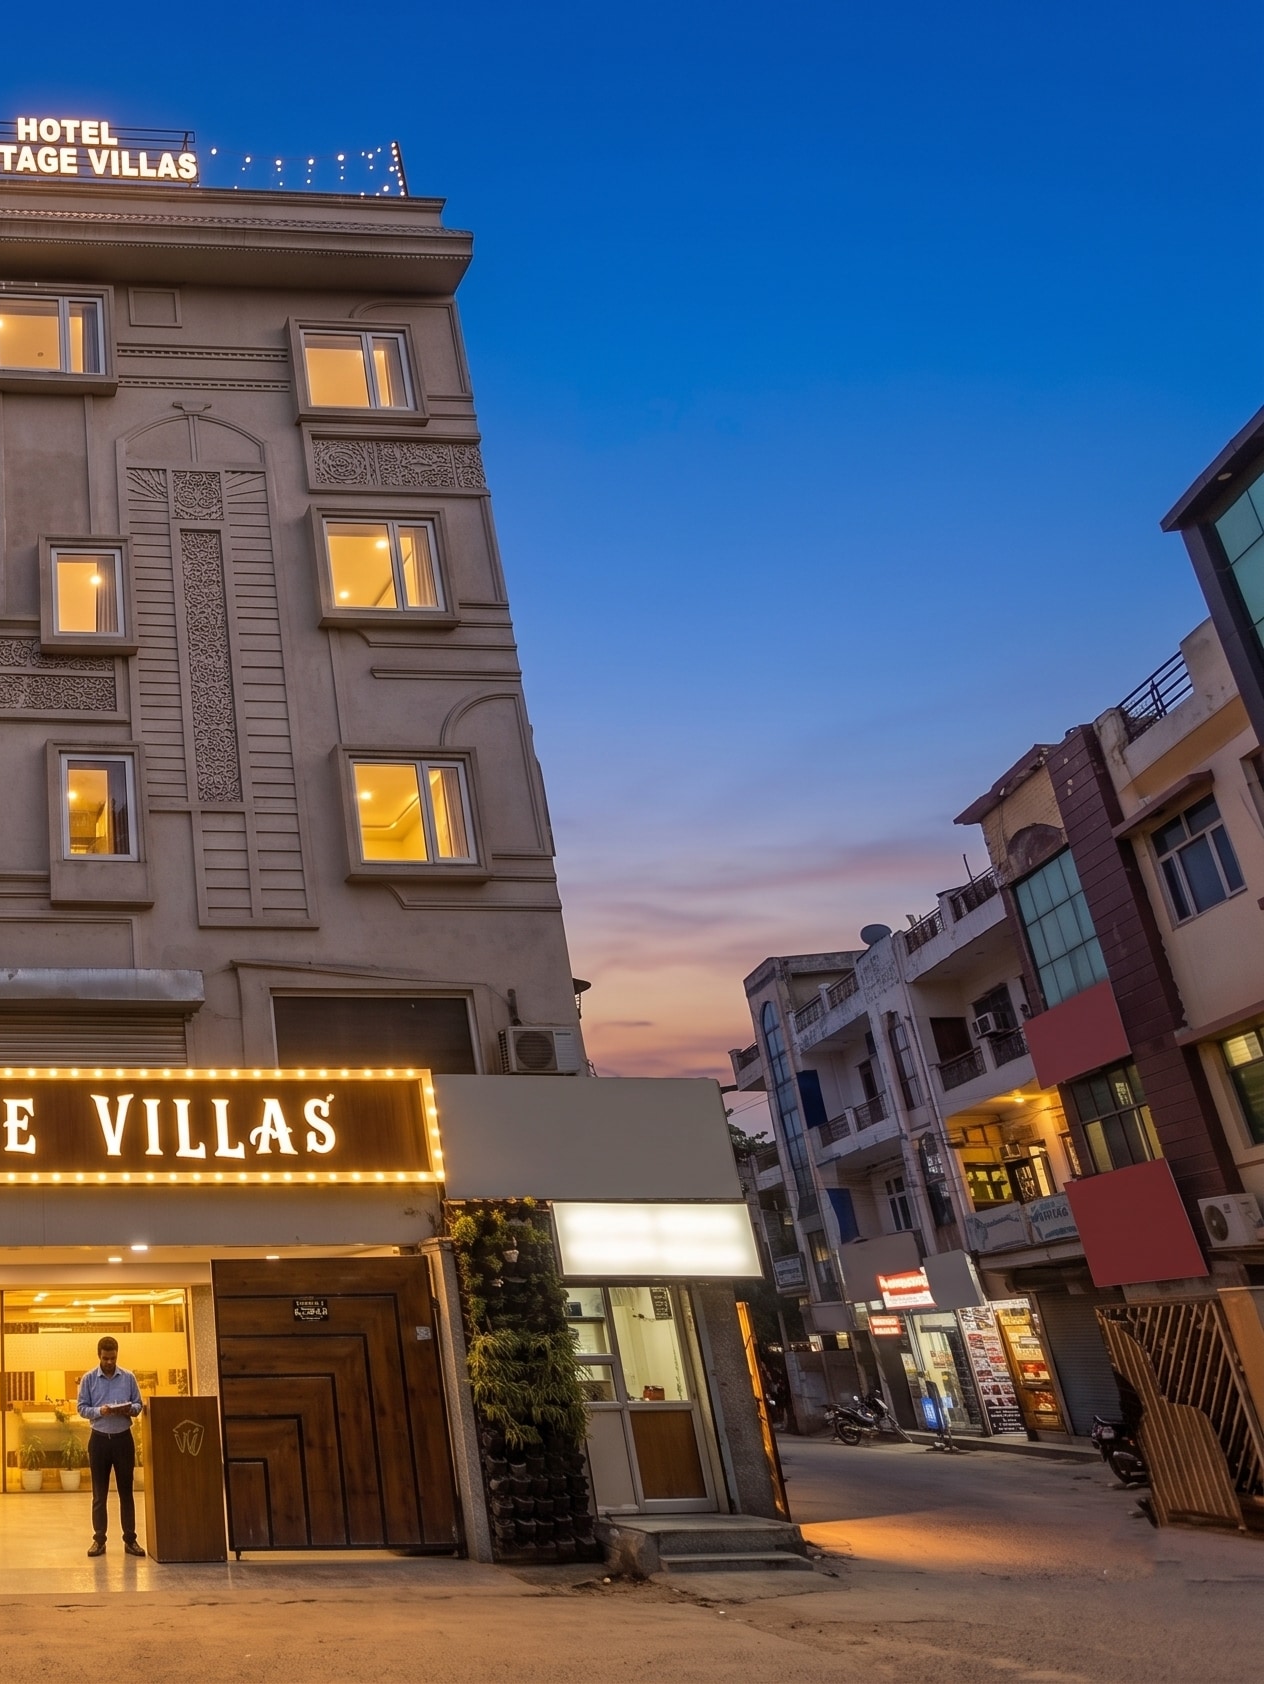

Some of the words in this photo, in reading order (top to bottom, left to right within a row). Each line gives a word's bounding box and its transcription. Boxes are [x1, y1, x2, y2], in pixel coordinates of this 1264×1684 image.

[16, 117, 118, 146] HOTEL
[88, 148, 198, 180] VILLAS
[90, 1093, 336, 1160] VILLAS
